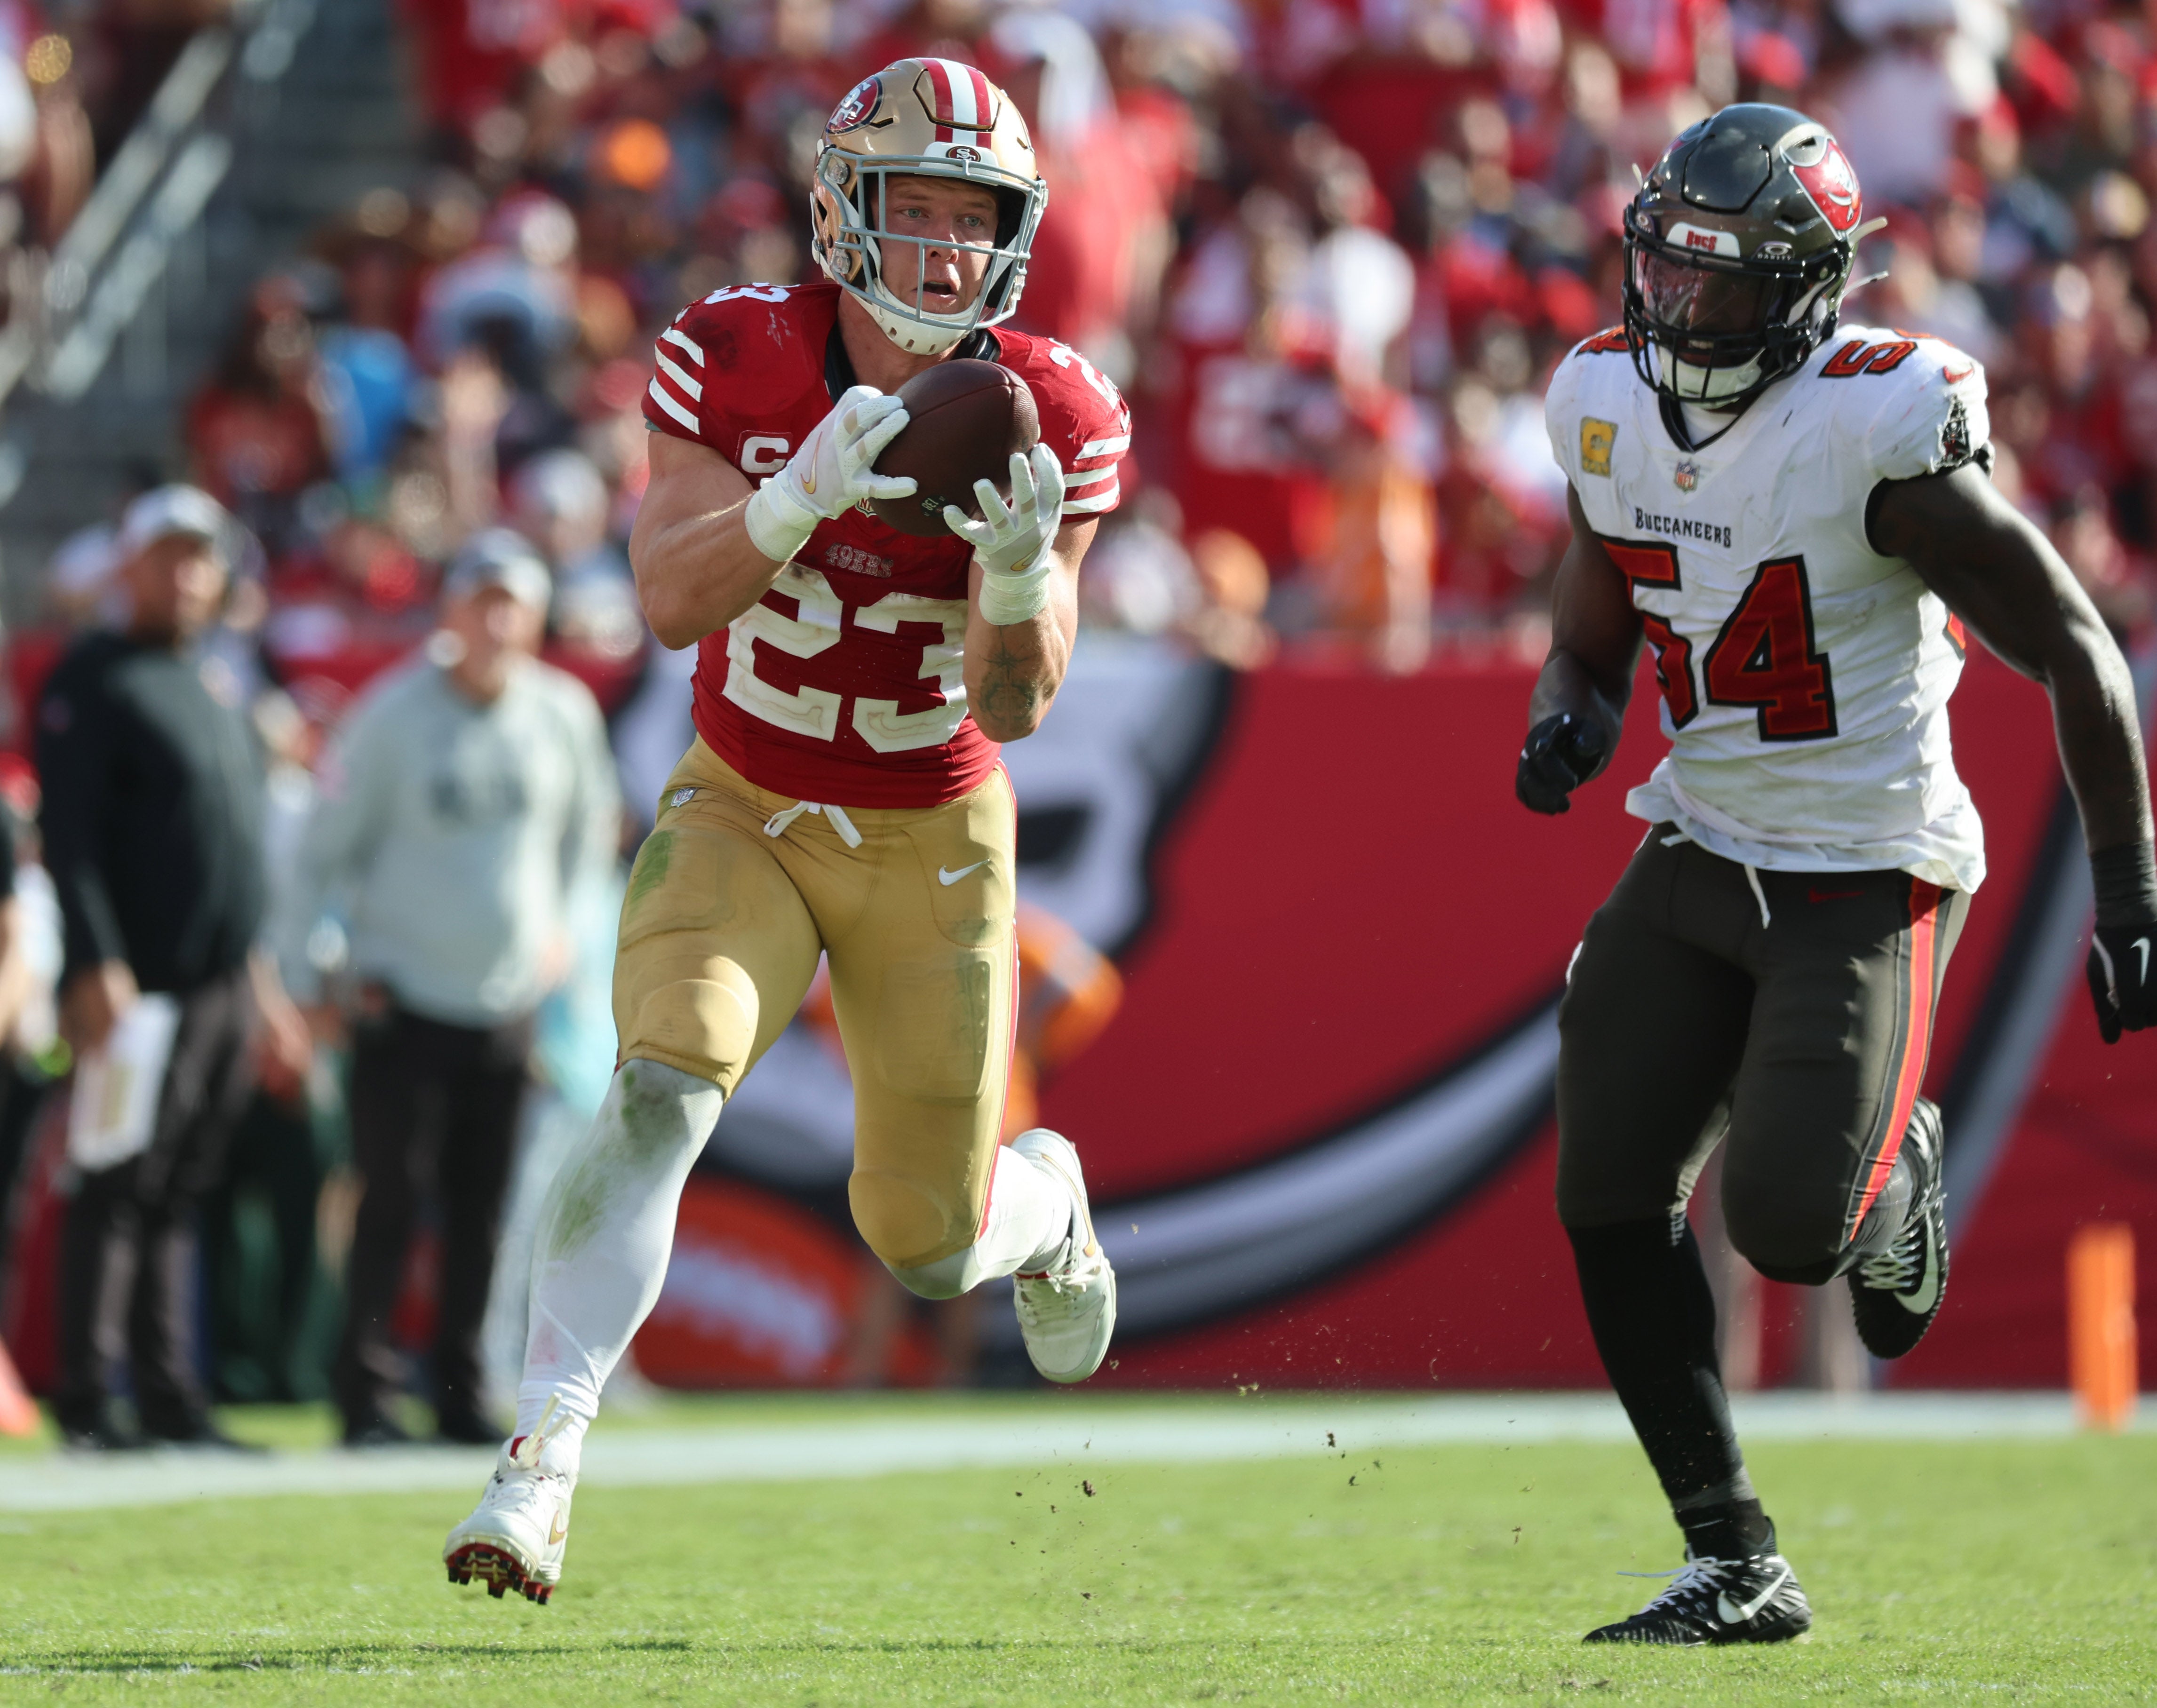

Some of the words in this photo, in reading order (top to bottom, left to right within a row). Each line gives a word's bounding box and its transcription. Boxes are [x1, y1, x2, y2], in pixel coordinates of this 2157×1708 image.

[740, 437, 789, 474] C
[1583, 421, 1613, 463] C
[826, 542, 894, 578] 49ERS
[721, 561, 969, 753] 23
[1593, 532, 1838, 742] 54
